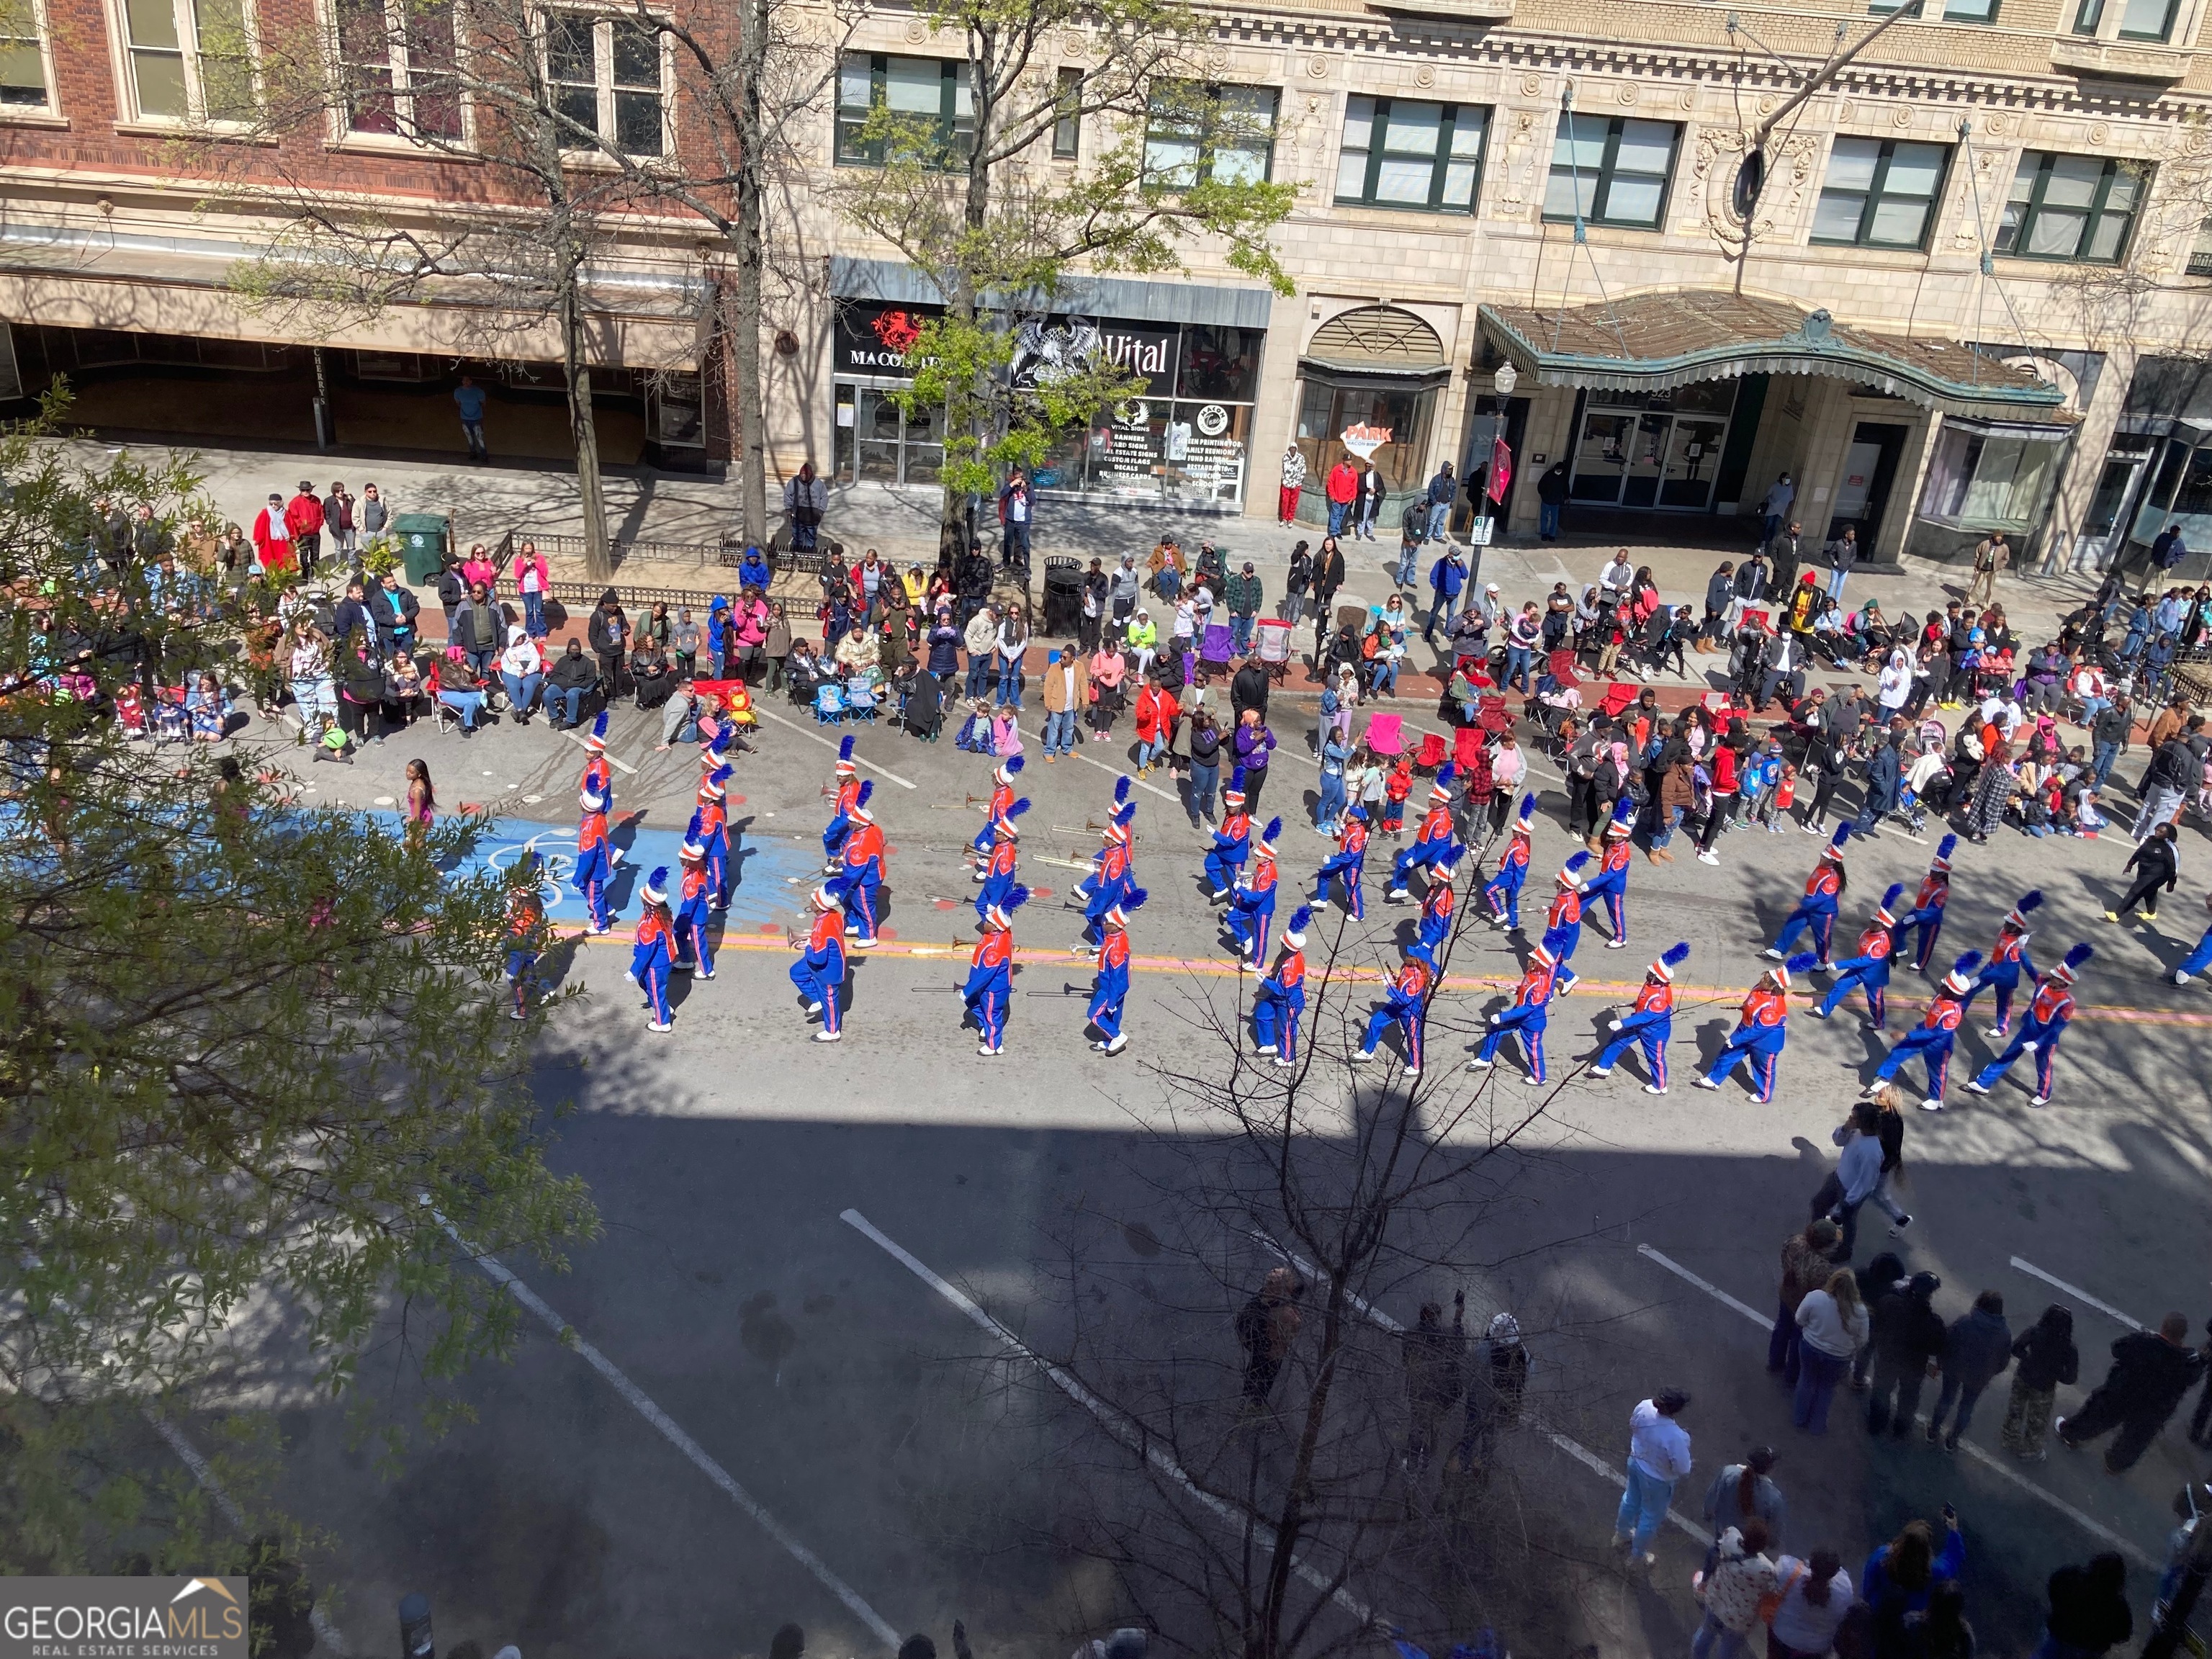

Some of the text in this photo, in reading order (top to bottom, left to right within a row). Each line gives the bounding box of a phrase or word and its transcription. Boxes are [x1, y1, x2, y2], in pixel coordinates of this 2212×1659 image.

[850, 350, 913, 369] MACON
[1105, 335, 1168, 377] Vital
[1200, 406, 1226, 418] MACON
[1114, 433, 1145, 442] BANNERS
[1346, 425, 1393, 442] PARK
[1205, 448, 1236, 457] REUNIONS
